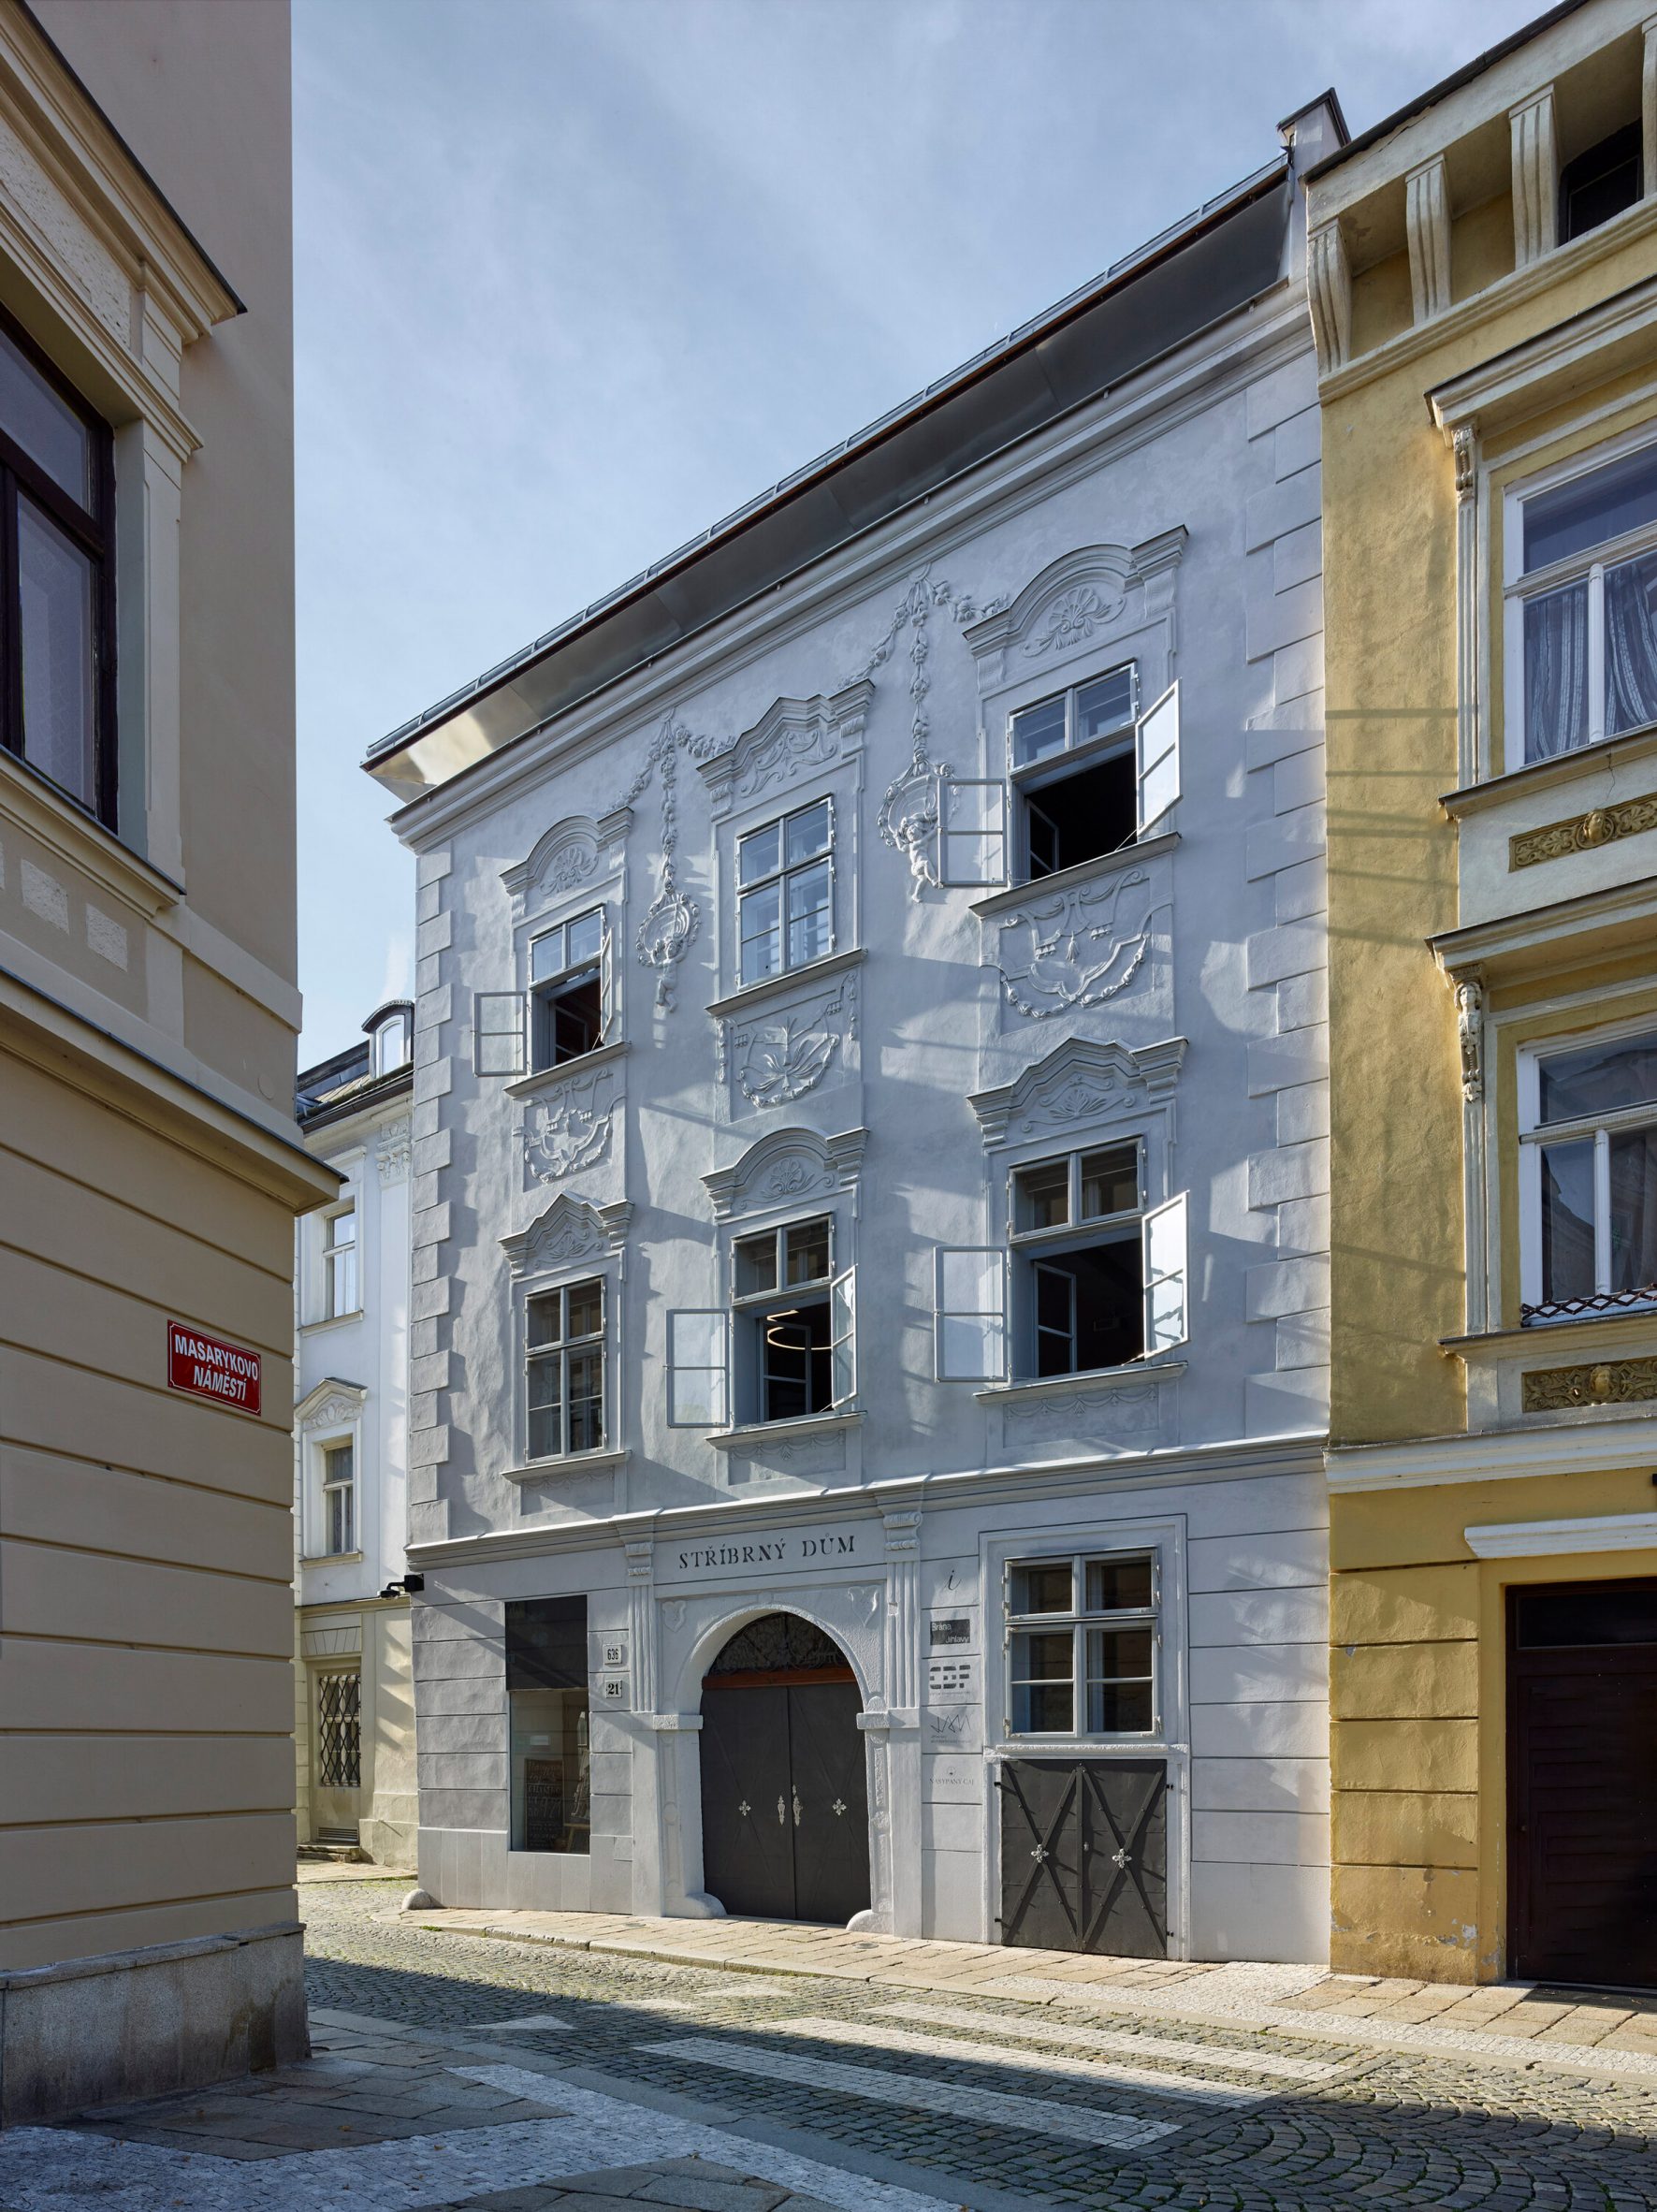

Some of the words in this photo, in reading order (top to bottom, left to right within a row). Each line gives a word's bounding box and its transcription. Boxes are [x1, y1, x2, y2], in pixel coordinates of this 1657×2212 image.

[175, 1334, 258, 1381] MASARYKOVO
[194, 1365, 247, 1401] NÁMĚSTÍ
[679, 1538, 786, 1569] STŘÍBRNÝ
[802, 1533, 854, 1557] DŮM
[607, 1648, 619, 1661] 636
[608, 1682, 619, 1695] 21
